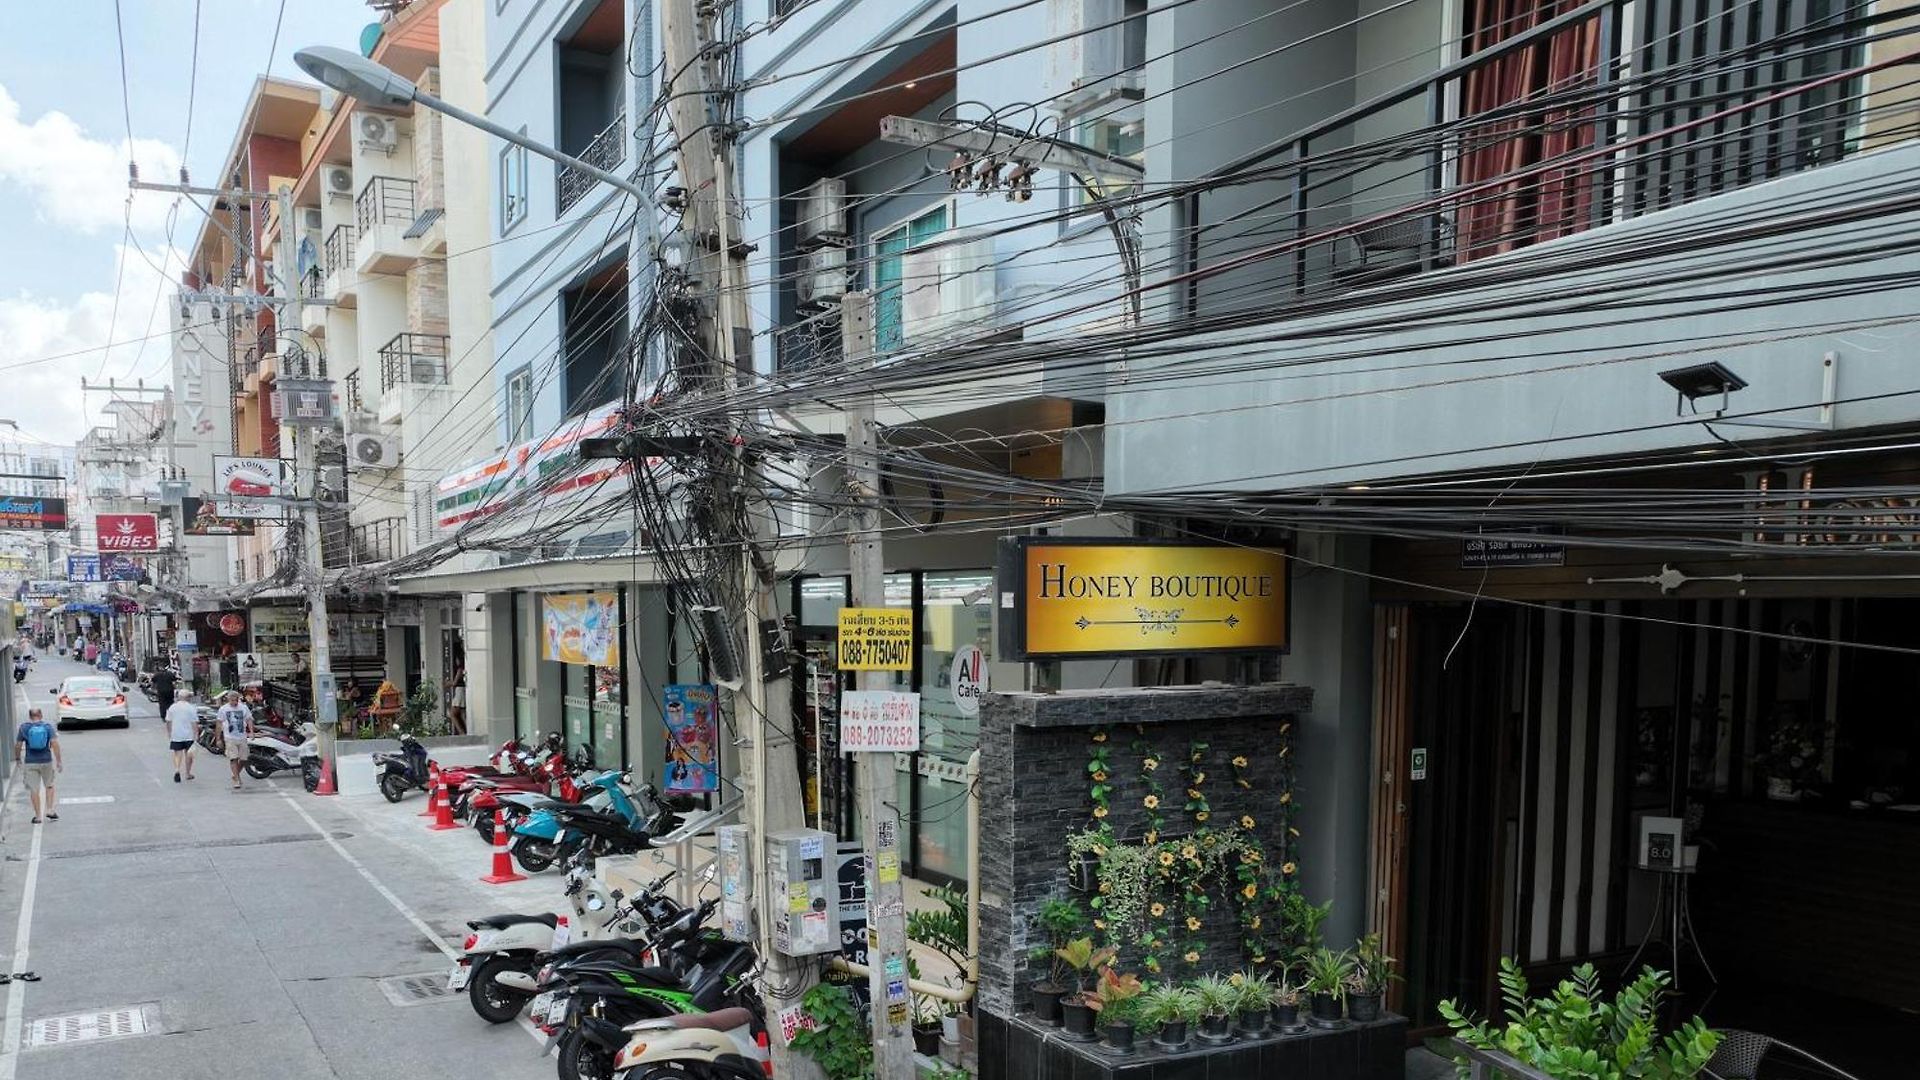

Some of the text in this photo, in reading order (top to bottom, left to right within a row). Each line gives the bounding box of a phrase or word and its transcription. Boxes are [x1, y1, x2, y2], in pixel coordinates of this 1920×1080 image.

[179, 307, 205, 431] ONEY
[101, 535, 152, 548] VIBES
[1039, 564, 1272, 601] HONEY BOUTIQUE
[842, 639, 910, 664] 088-7750407
[958, 650, 980, 682] All
[843, 725, 913, 746] 088-2073252
